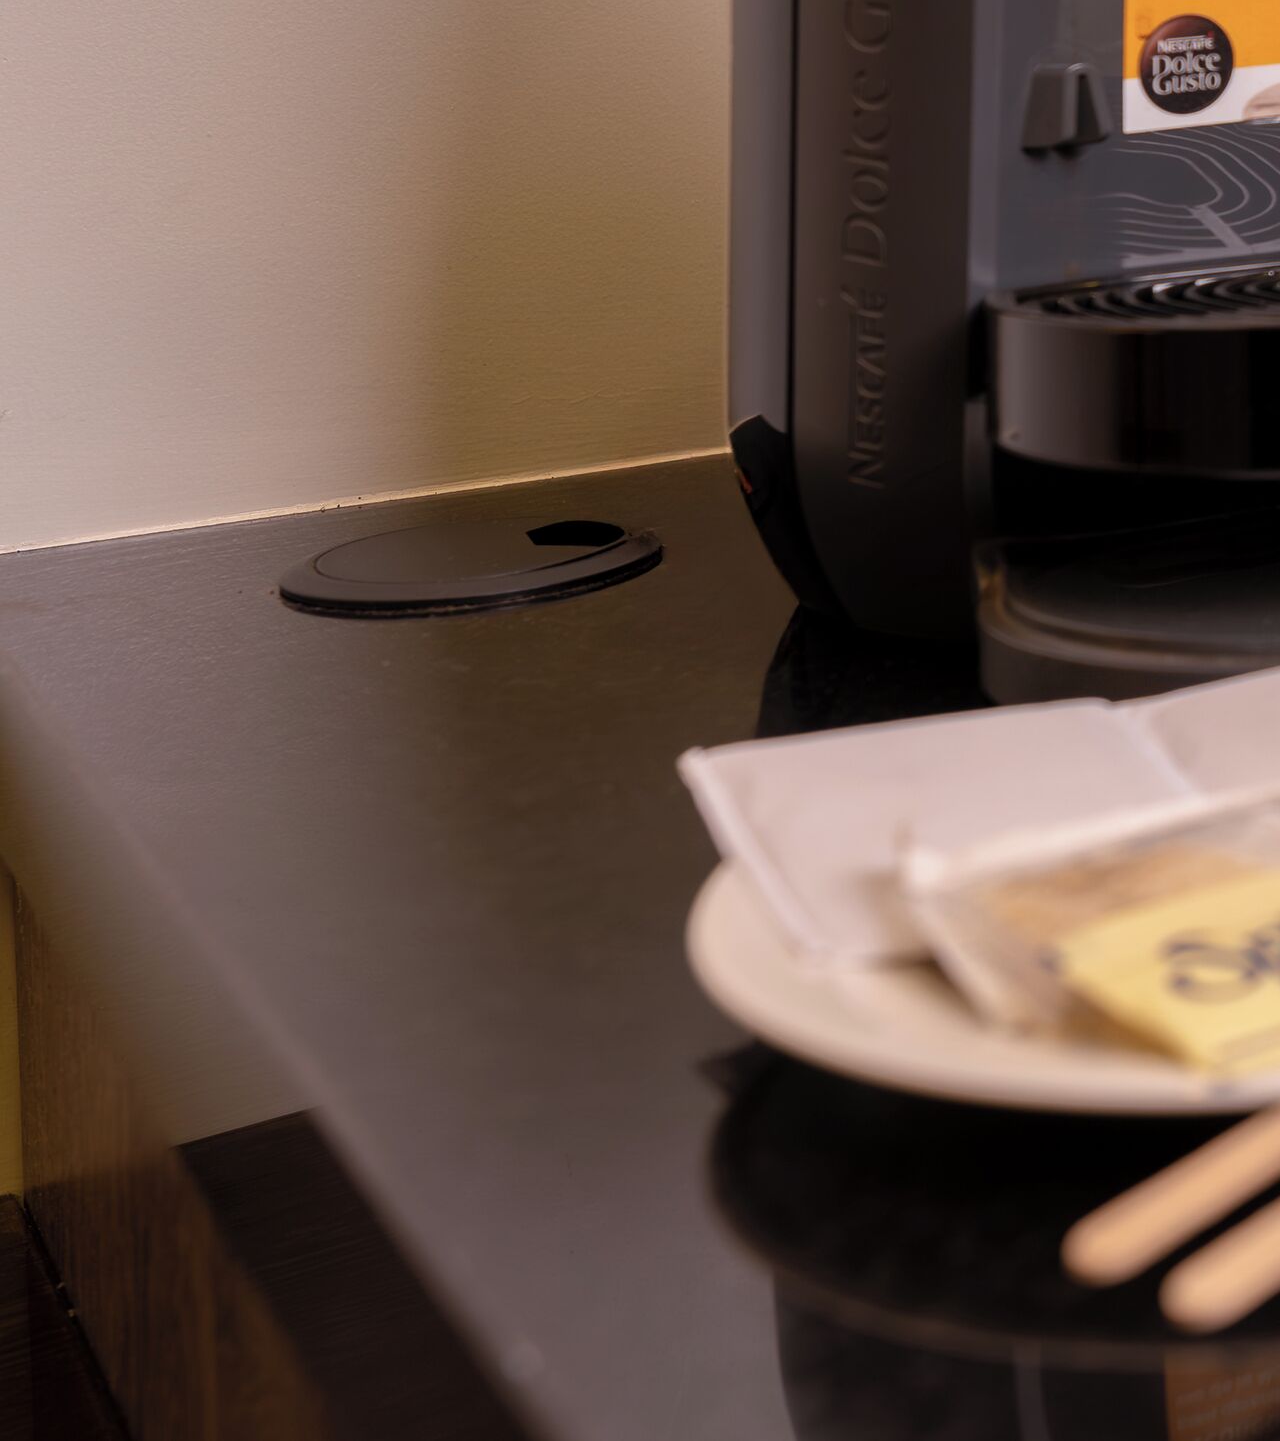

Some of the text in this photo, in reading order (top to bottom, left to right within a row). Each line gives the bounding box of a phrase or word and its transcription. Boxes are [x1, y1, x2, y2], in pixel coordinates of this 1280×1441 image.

[1151, 51, 1222, 77] Dolce
[1151, 70, 1222, 96] Gusto
[840, 69, 892, 268] Dolce
